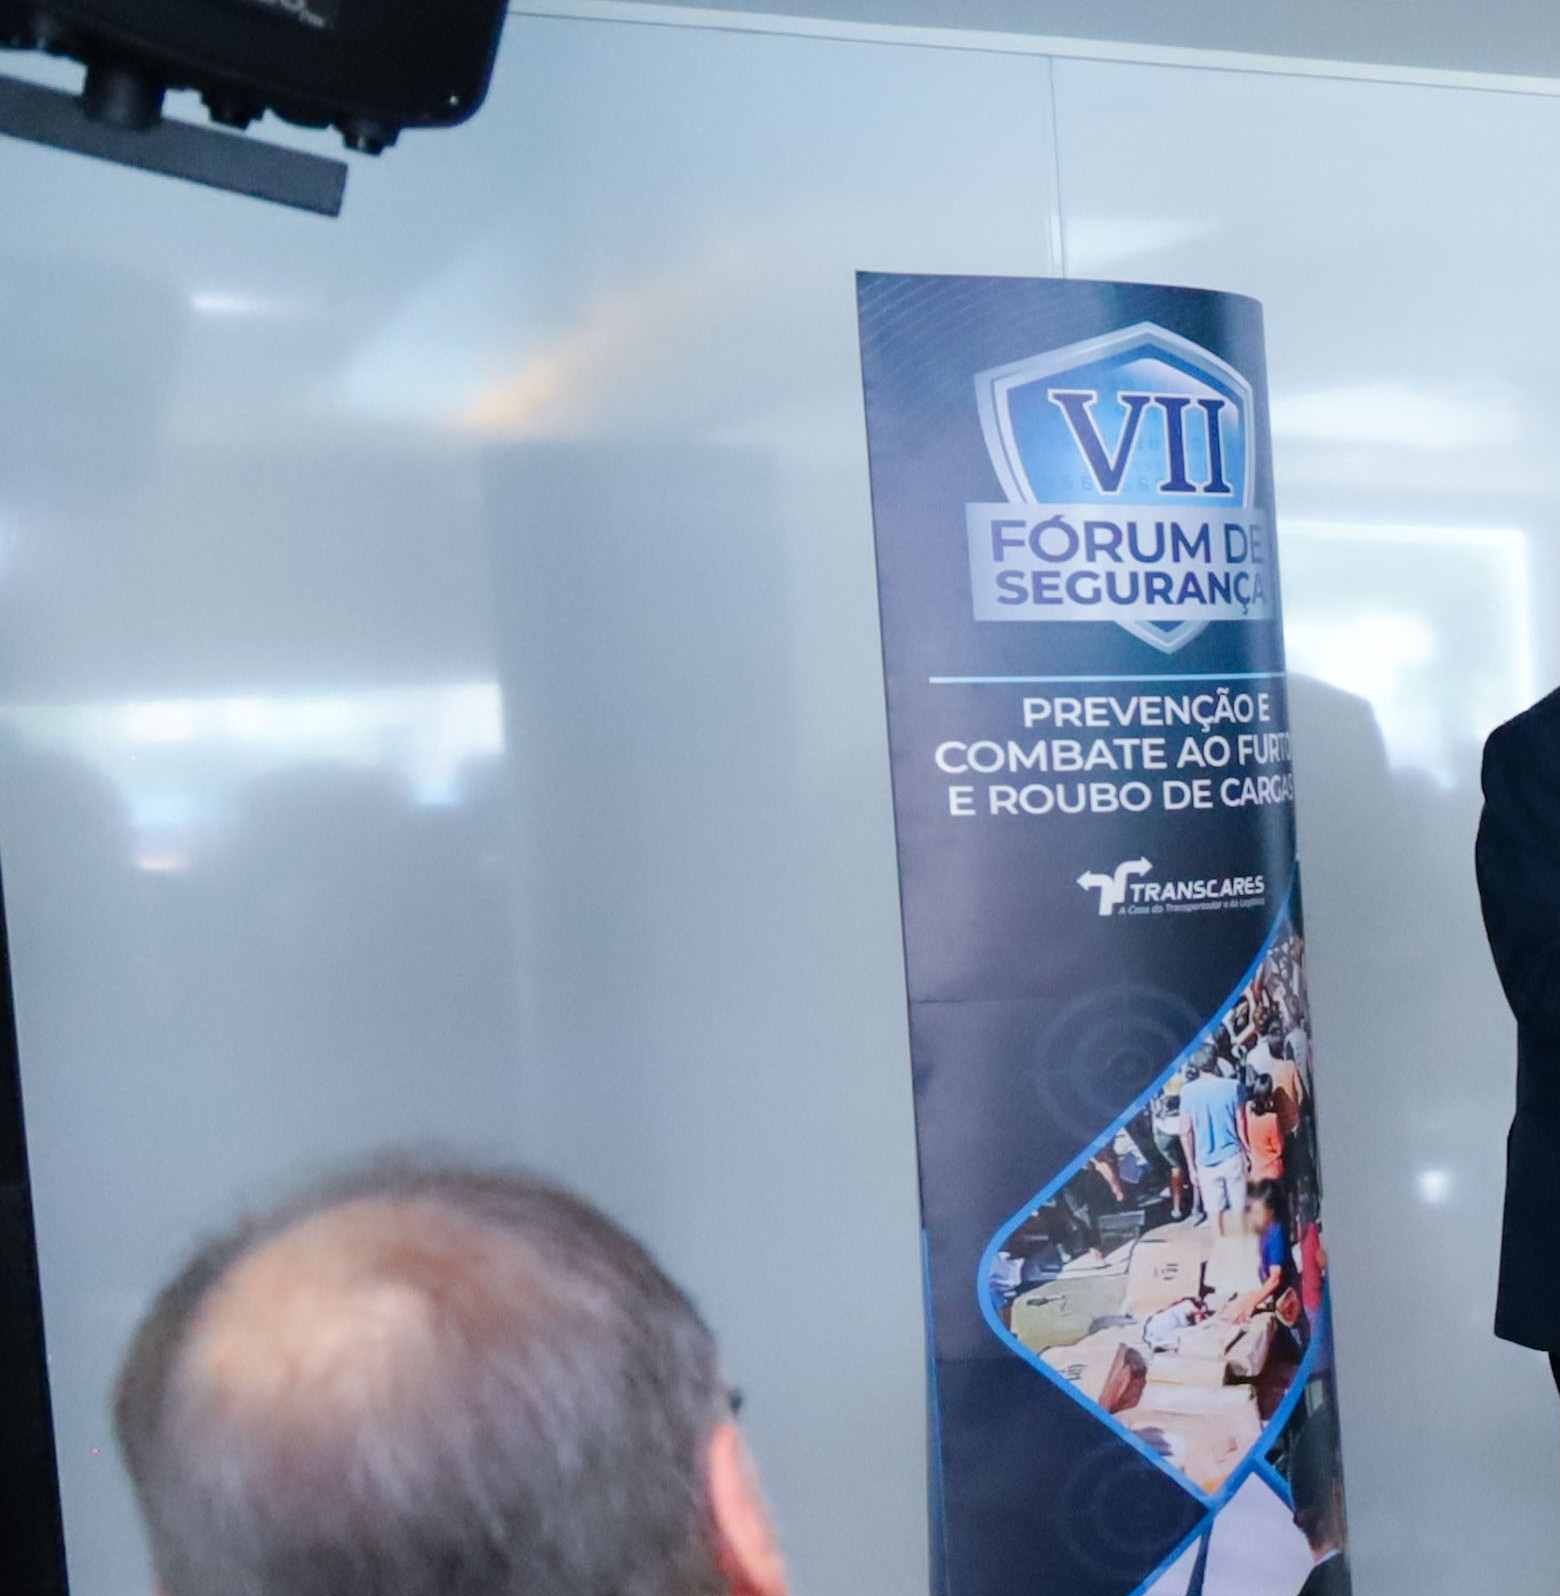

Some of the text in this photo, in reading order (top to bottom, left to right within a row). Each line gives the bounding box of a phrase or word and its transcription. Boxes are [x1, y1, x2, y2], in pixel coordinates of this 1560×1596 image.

[1049, 390, 1232, 495] VII
[990, 515, 1265, 564] FÓRUM DE
[995, 569, 1266, 615] SEGURANÇA
[1023, 687, 1270, 733] PREVENÇÃO E
[934, 737, 1168, 774] COMBATE
[1176, 735, 1231, 769] AO
[948, 773, 1294, 816] E ROUBO DE CARGAS
[1129, 876, 1265, 902] TRANSCARES
